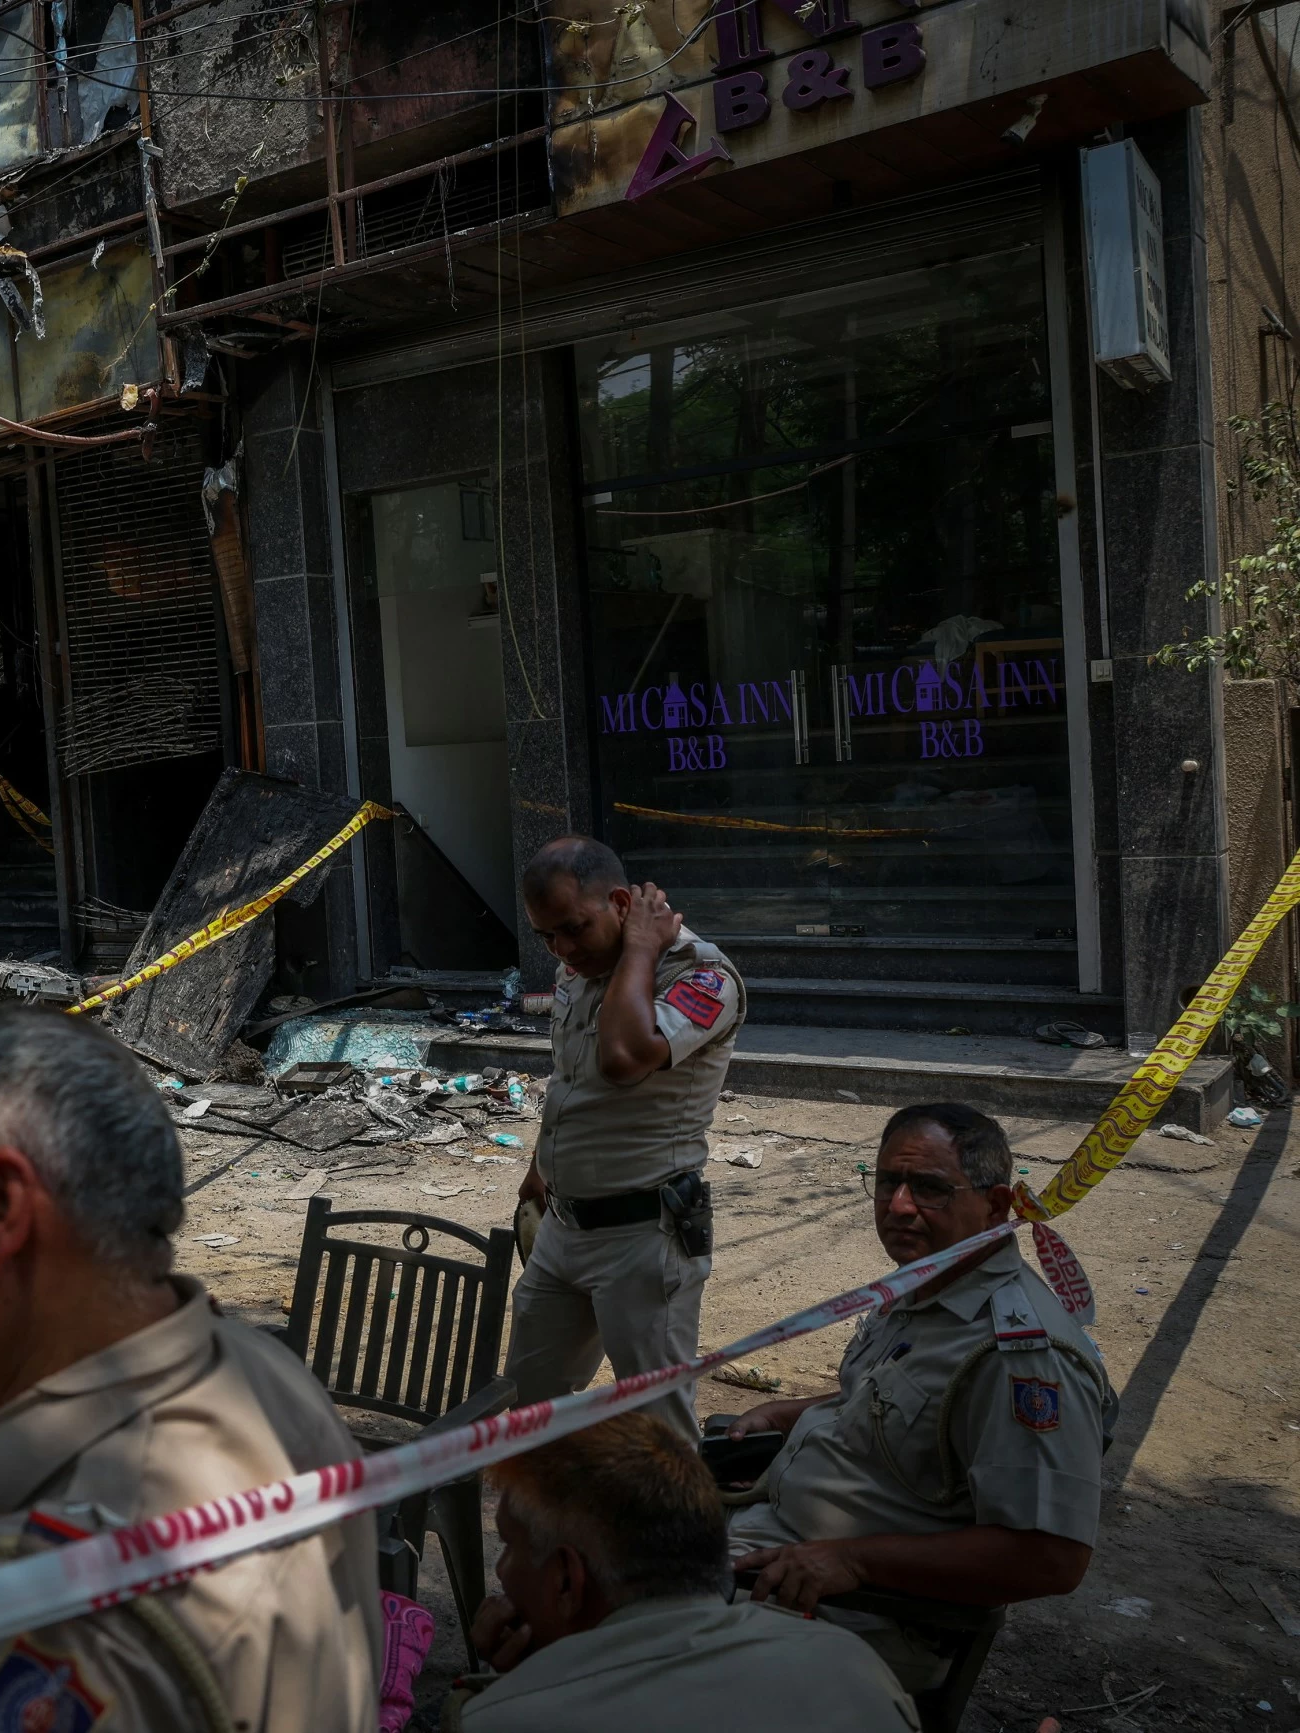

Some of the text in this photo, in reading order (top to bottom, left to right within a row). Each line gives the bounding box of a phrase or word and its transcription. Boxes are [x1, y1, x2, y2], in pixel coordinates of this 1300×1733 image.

[600, 692, 638, 734] MI
[733, 679, 793, 725] INN
[847, 671, 888, 717] MI
[997, 658, 1059, 708] INN
[667, 734, 728, 772] B&B
[919, 717, 985, 760] B&B
[112, 1481, 294, 1563] CAUTION
